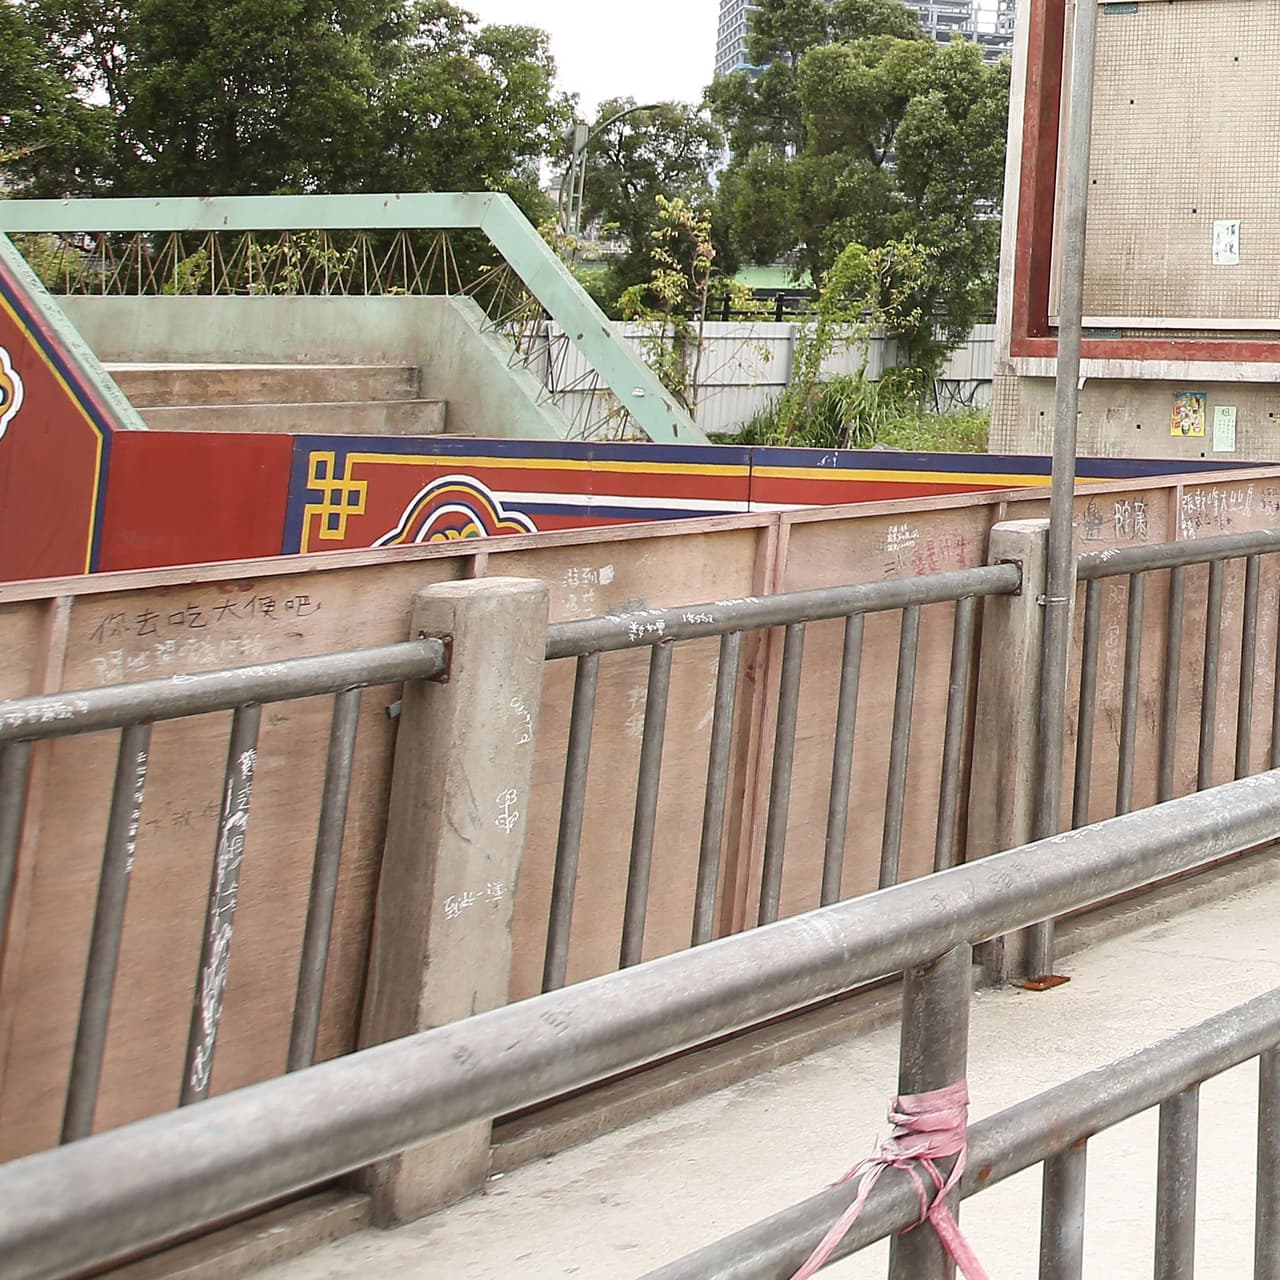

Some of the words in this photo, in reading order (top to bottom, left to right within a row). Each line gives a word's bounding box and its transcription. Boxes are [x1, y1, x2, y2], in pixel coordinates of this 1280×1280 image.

[89, 594, 322, 642] 你去吃大便吧
